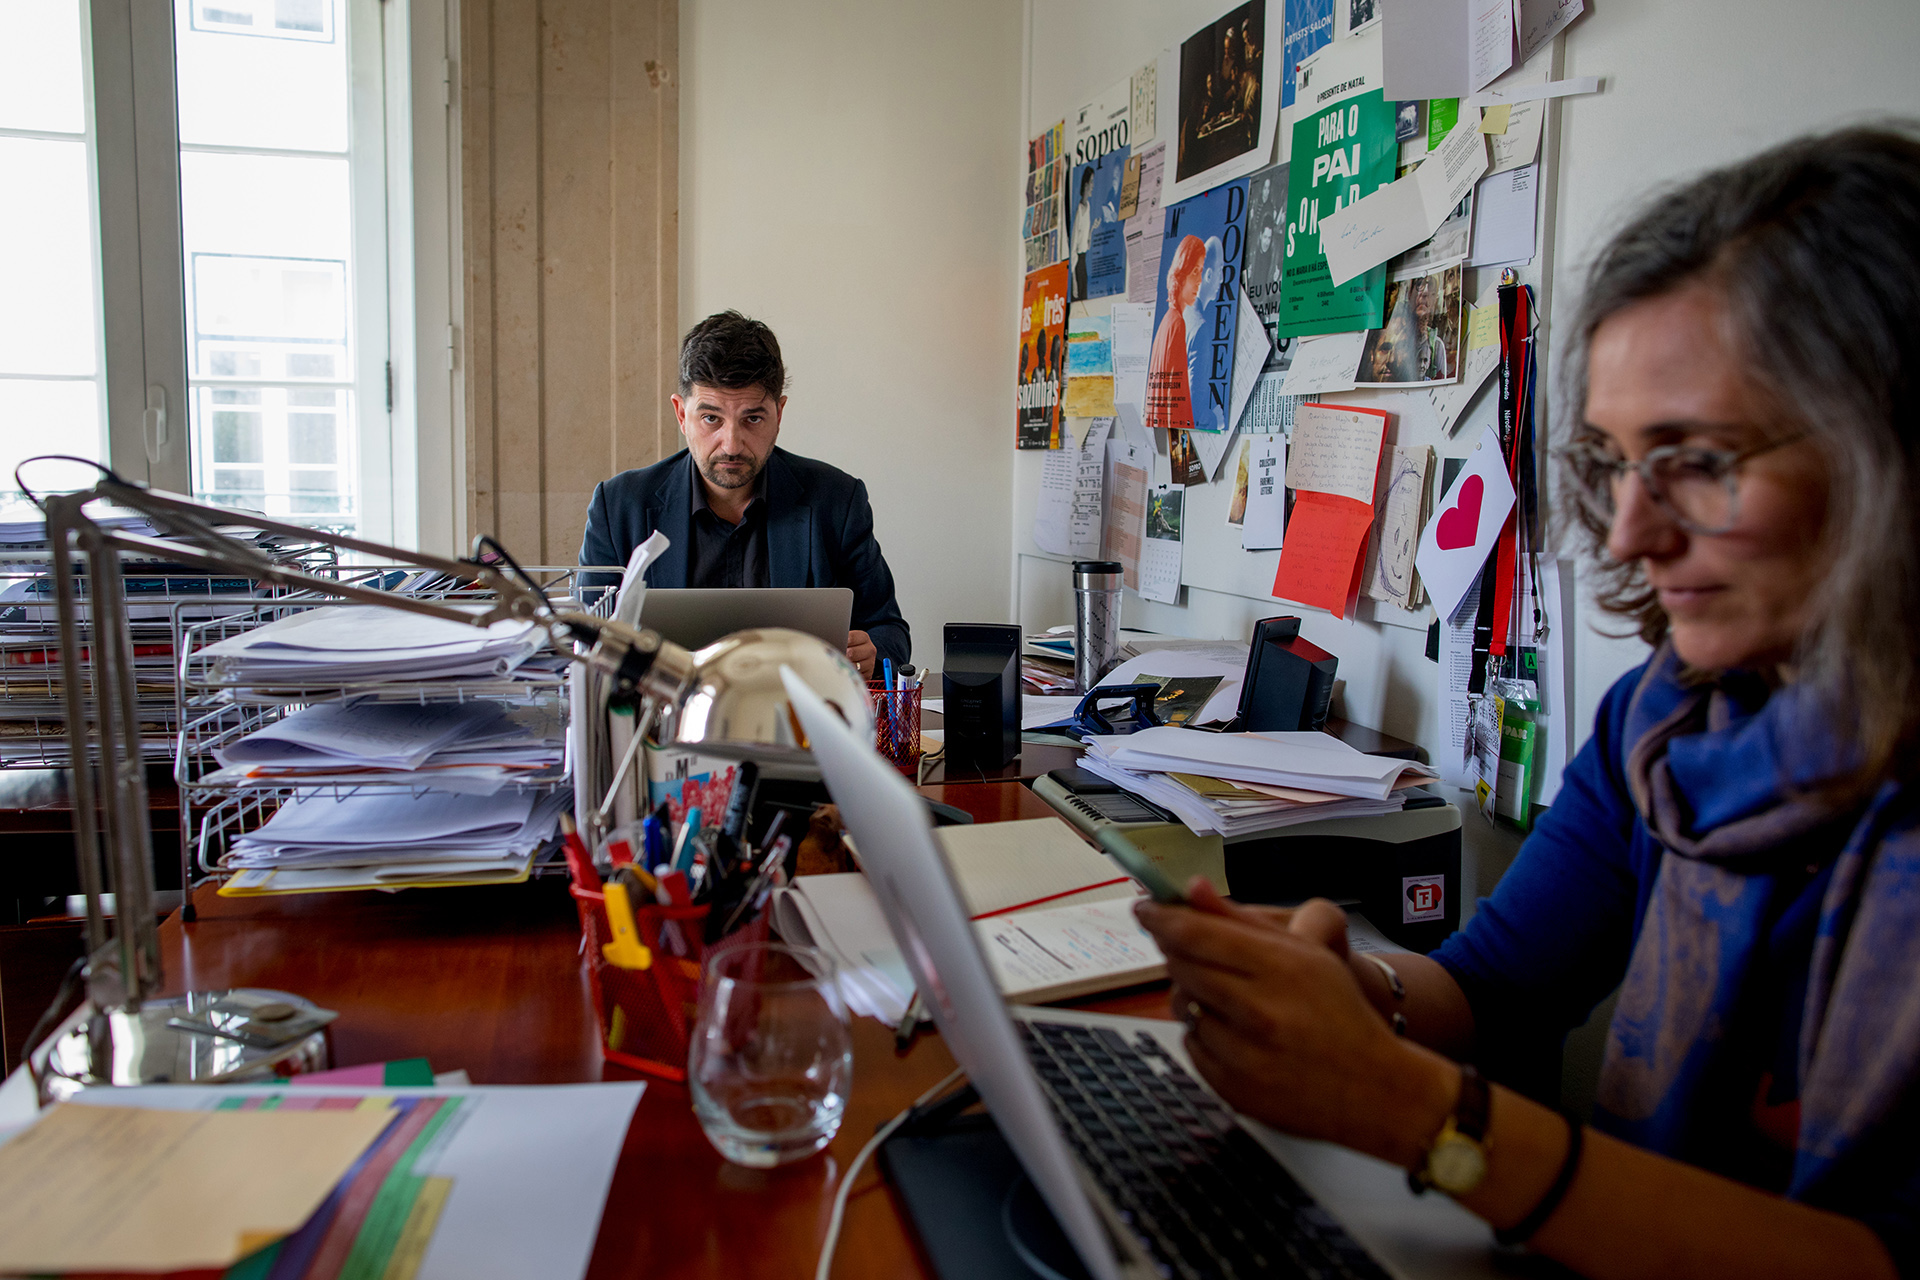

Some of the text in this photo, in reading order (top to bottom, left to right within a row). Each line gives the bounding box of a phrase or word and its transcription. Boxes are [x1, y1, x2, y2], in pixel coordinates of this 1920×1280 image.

[1310, 14, 1332, 33] SALON
[1320, 85, 1340, 100] PRESENTE
[1340, 81, 1347, 92] DE
[1347, 76, 1365, 90] NATAL
[1318, 104, 1359, 149] PARA O
[1075, 119, 1128, 170] sopro
[1312, 143, 1361, 188] PAI
[1208, 185, 1245, 417] DOREEN
[1249, 284, 1262, 298] EU
[1043, 293, 1065, 327] três
[1017, 377, 1059, 410] sozinhas
[1528, 654, 1535, 667] A
